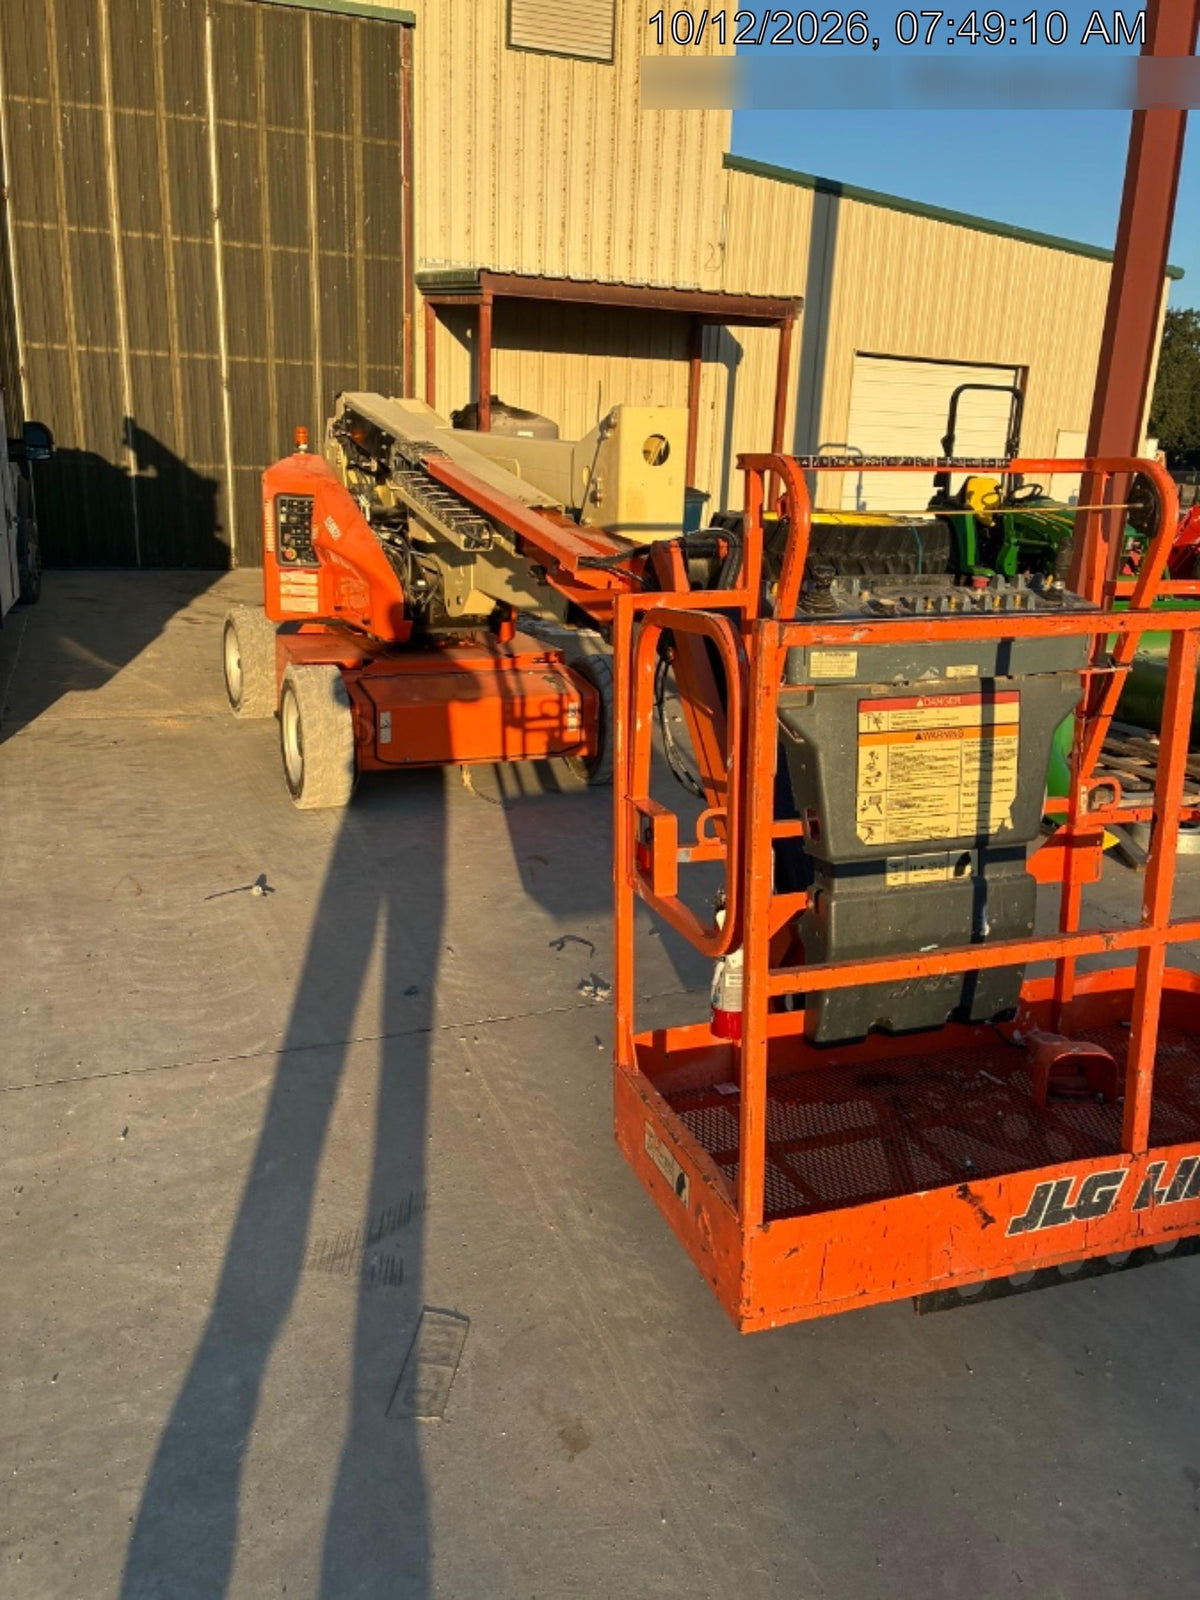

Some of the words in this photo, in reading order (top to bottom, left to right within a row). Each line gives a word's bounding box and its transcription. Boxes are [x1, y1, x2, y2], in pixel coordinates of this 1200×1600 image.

[924, 696, 962, 707] DANGER
[922, 728, 965, 741] WARNING
[1005, 1168, 1130, 1237] JLG
